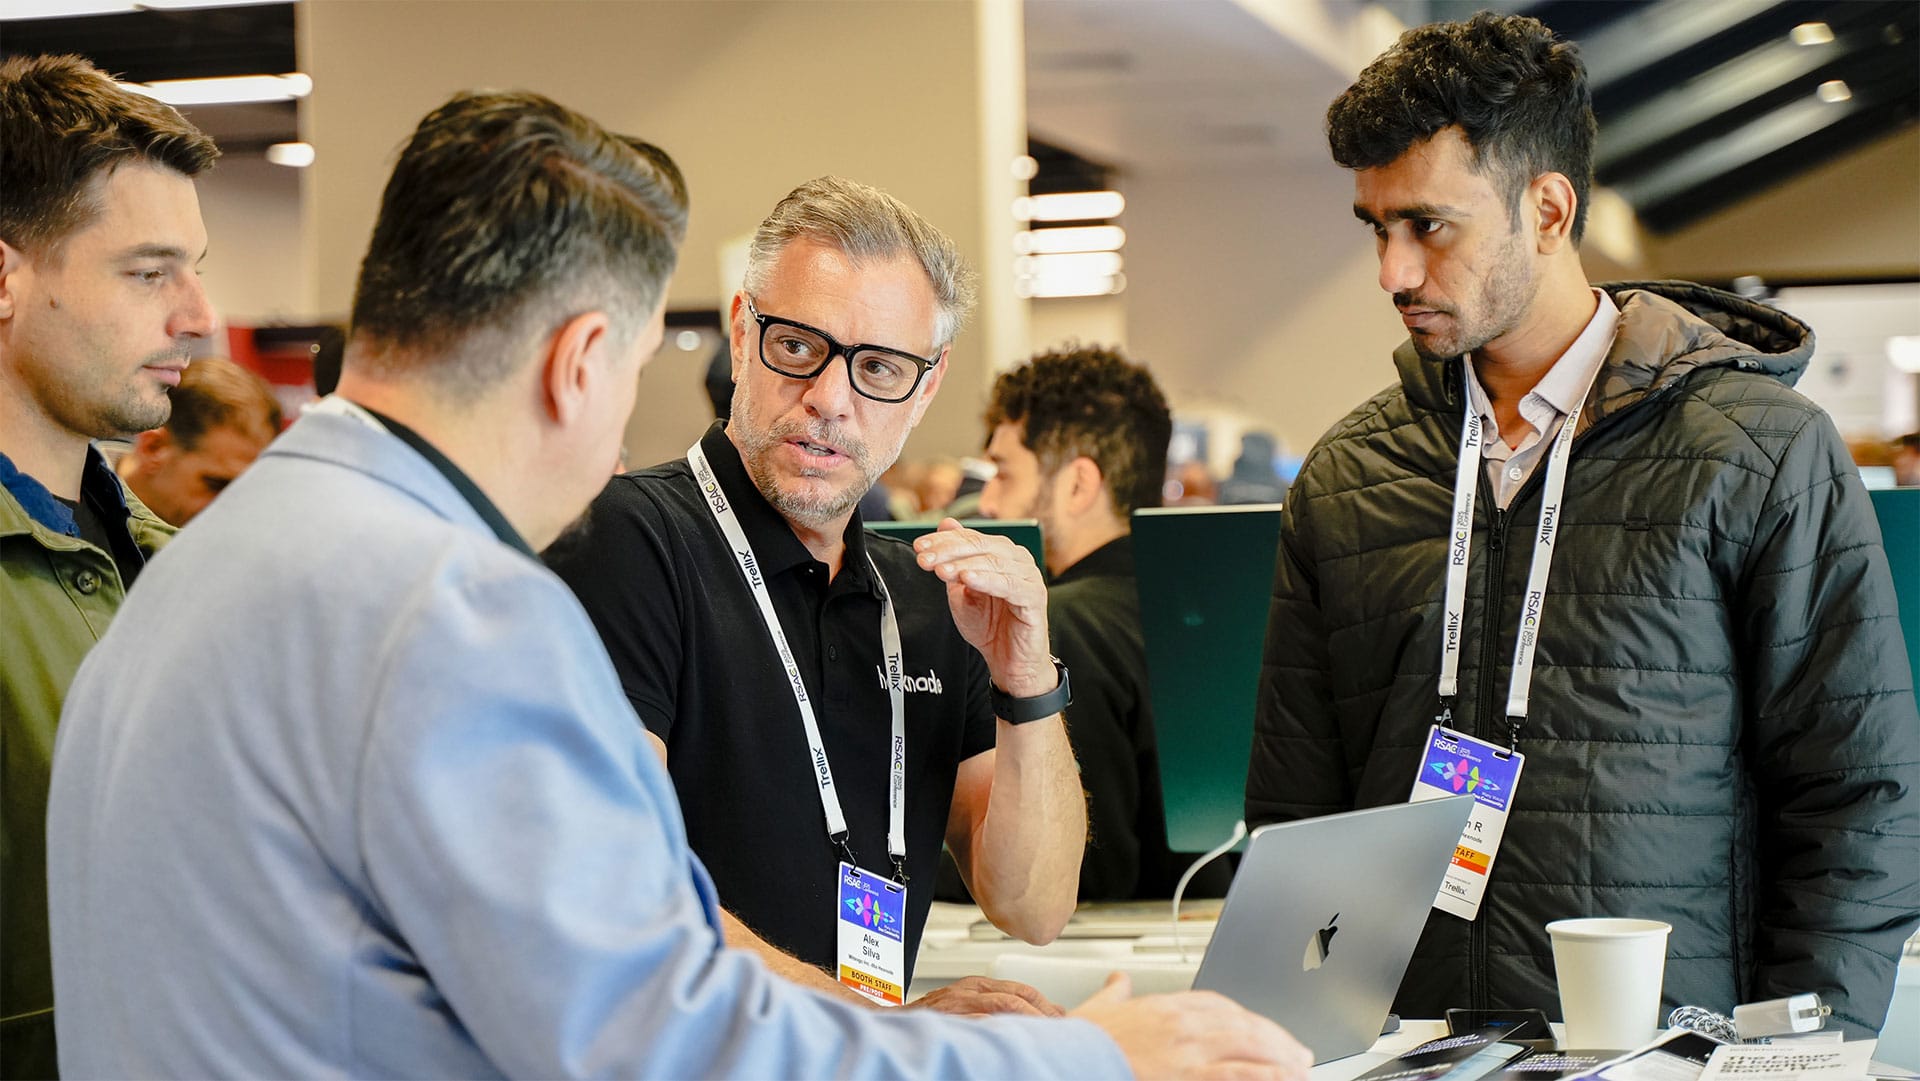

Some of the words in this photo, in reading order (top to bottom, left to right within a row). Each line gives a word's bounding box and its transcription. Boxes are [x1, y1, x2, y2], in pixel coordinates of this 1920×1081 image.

[706, 482, 728, 513] RSAC
[1463, 492, 1471, 527] Conference
[1539, 503, 1557, 546] Trellix
[1453, 531, 1467, 566] RSAC
[738, 550, 763, 589] Trellix
[1525, 591, 1541, 626] RSAC
[1446, 611, 1459, 654] Trellix
[1518, 631, 1527, 666] Conference
[788, 668, 807, 702] RSAC
[877, 665, 943, 694] hxnode
[888, 653, 902, 692] Trellix
[894, 735, 903, 770] RSAC
[1434, 738, 1458, 754] RSAC
[813, 747, 830, 789] Trellix
[1474, 821, 1483, 833] R
[1456, 846, 1475, 860] TAFF
[843, 875, 861, 889] RSAC
[1444, 881, 1466, 896] Trellix
[862, 946, 880, 961] Silva
[863, 933, 880, 948] Alex
[851, 970, 873, 985] BOOTH
[875, 979, 892, 991] STAFF
